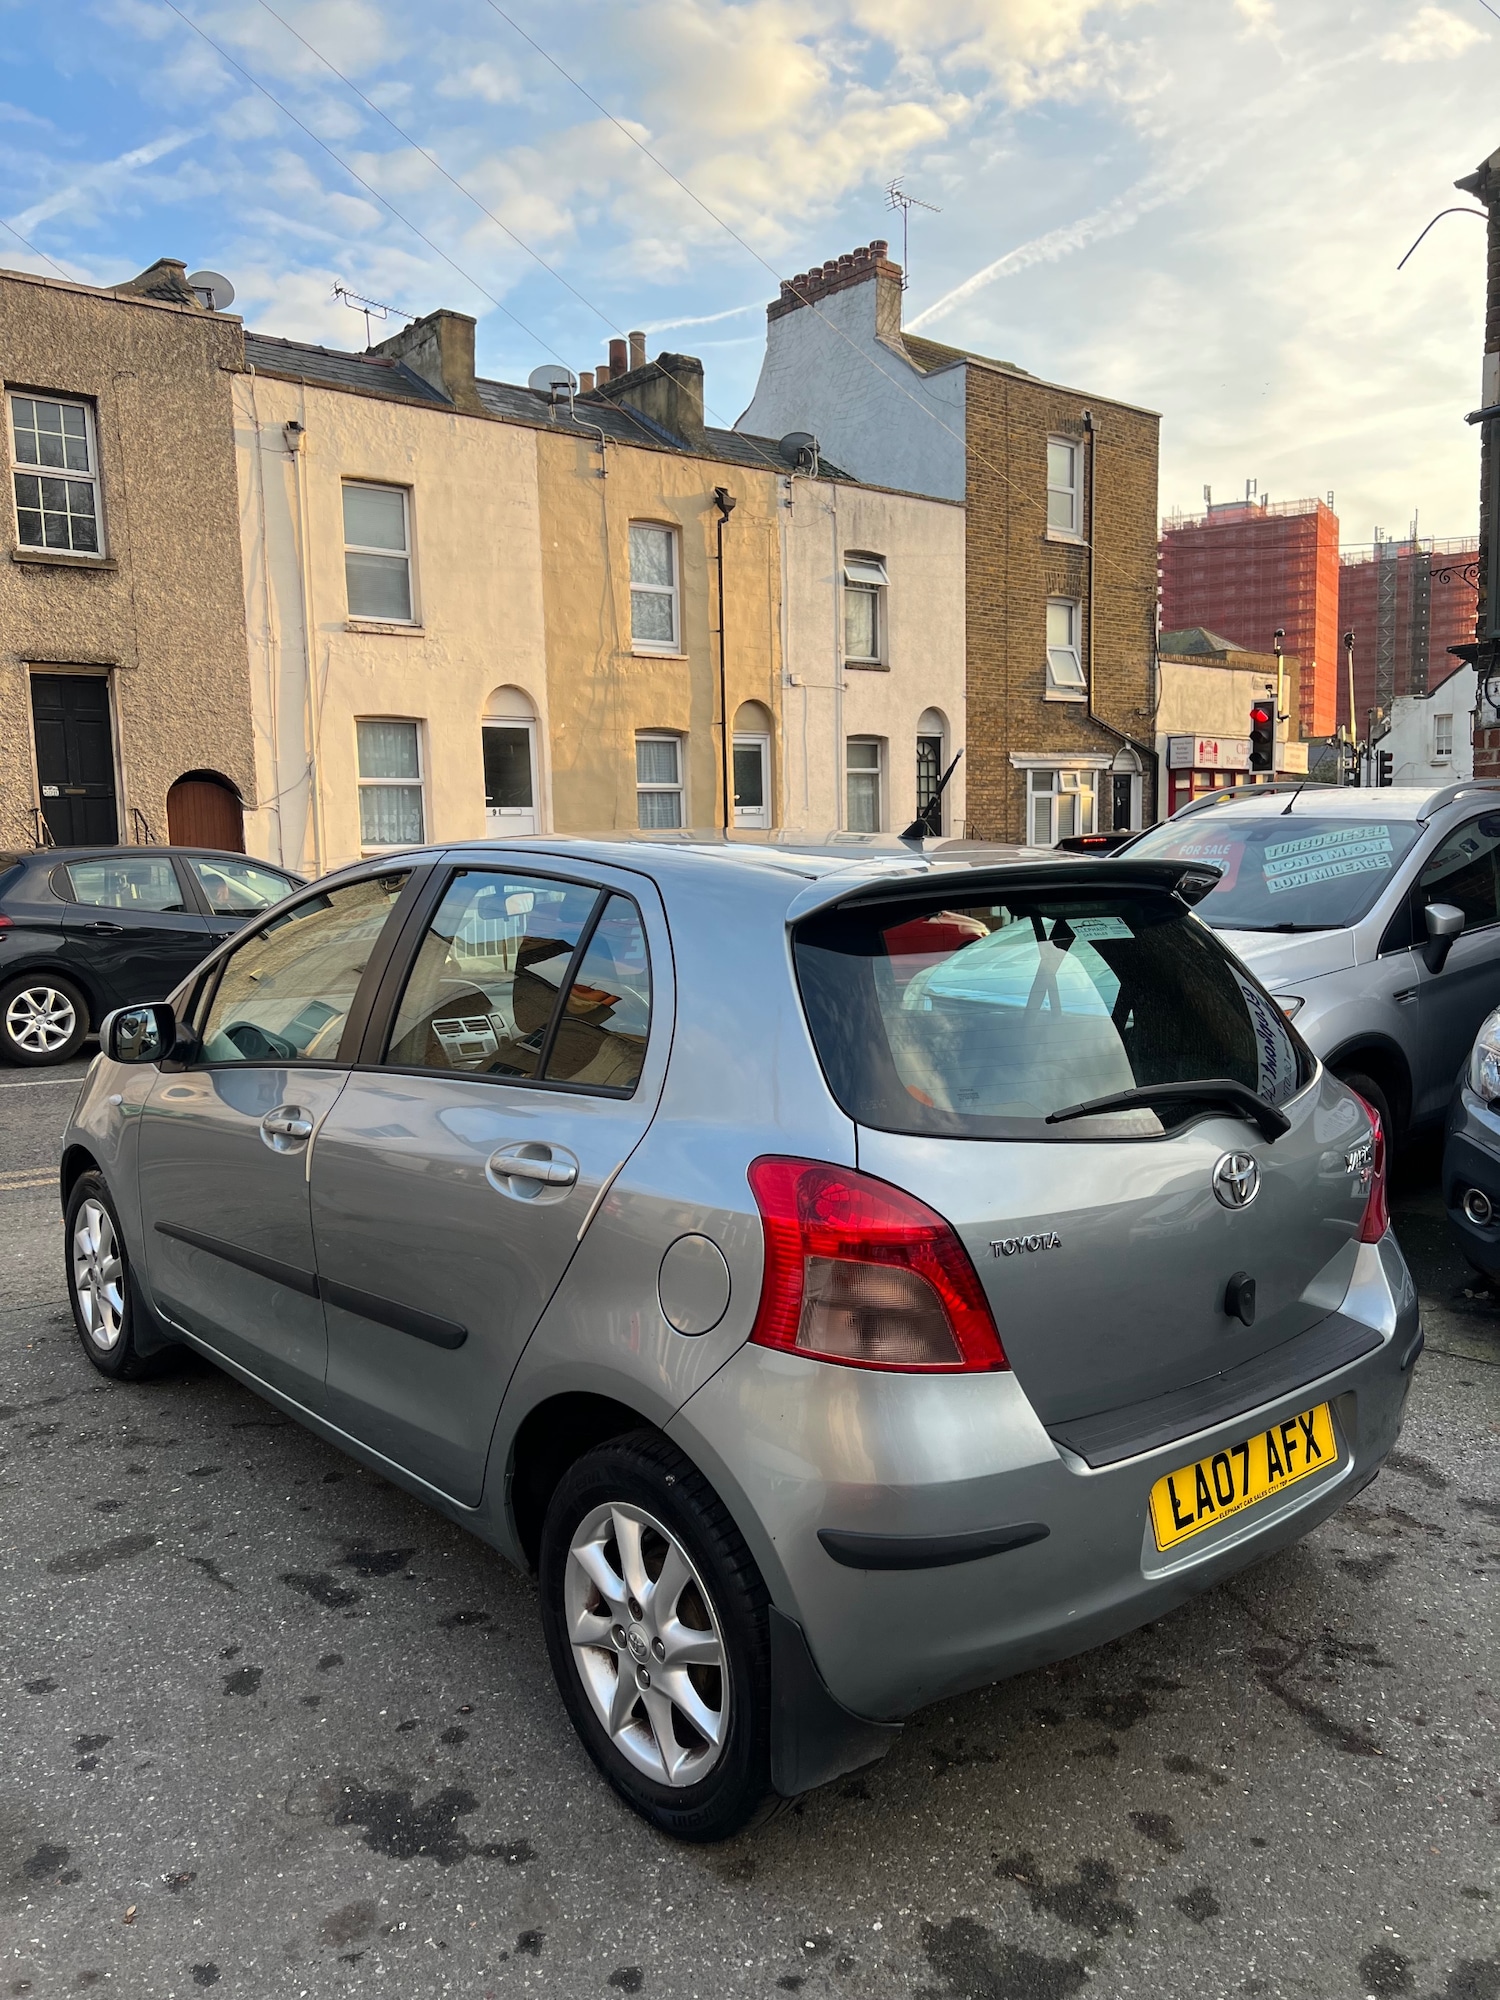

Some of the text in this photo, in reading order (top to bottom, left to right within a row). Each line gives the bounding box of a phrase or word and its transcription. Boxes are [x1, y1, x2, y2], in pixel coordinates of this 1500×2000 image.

[1179, 844, 1232, 856] FOR SALE
[1268, 826, 1386, 858] TURBO DIESEL
[1269, 851, 1324, 874] LONG
[1272, 855, 1389, 891] LOW MILEAGE
[990, 1232, 1062, 1258] TOYOTA
[1167, 1409, 1322, 1531] LA07 AFX
[1220, 1502, 1242, 1518] ELEPHANT
[1254, 1490, 1268, 1500] SALES
